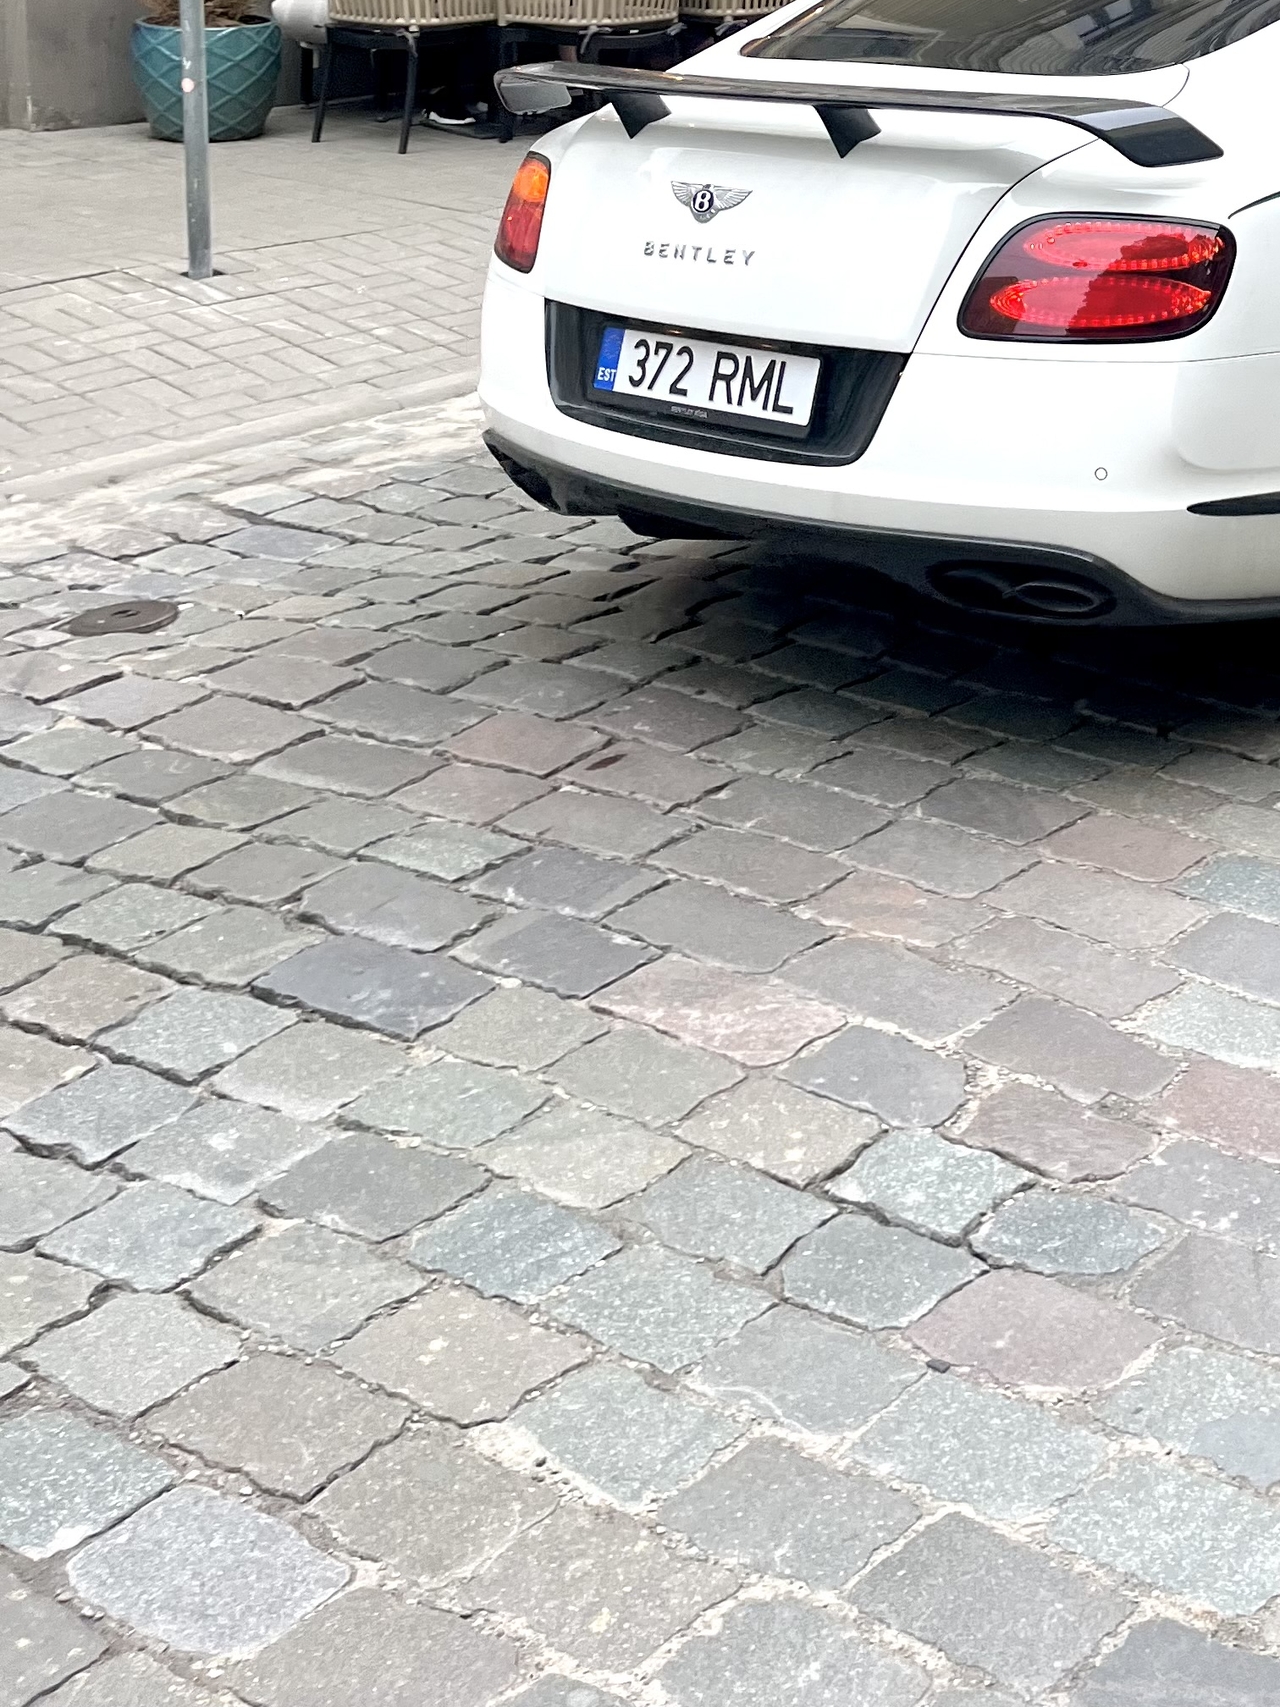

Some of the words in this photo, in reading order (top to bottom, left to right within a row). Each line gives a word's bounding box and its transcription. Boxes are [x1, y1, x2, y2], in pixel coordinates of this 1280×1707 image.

[644, 240, 756, 266] BENTLEY
[597, 366, 617, 381] EST
[628, 339, 694, 397] 372
[708, 351, 794, 415] RML
